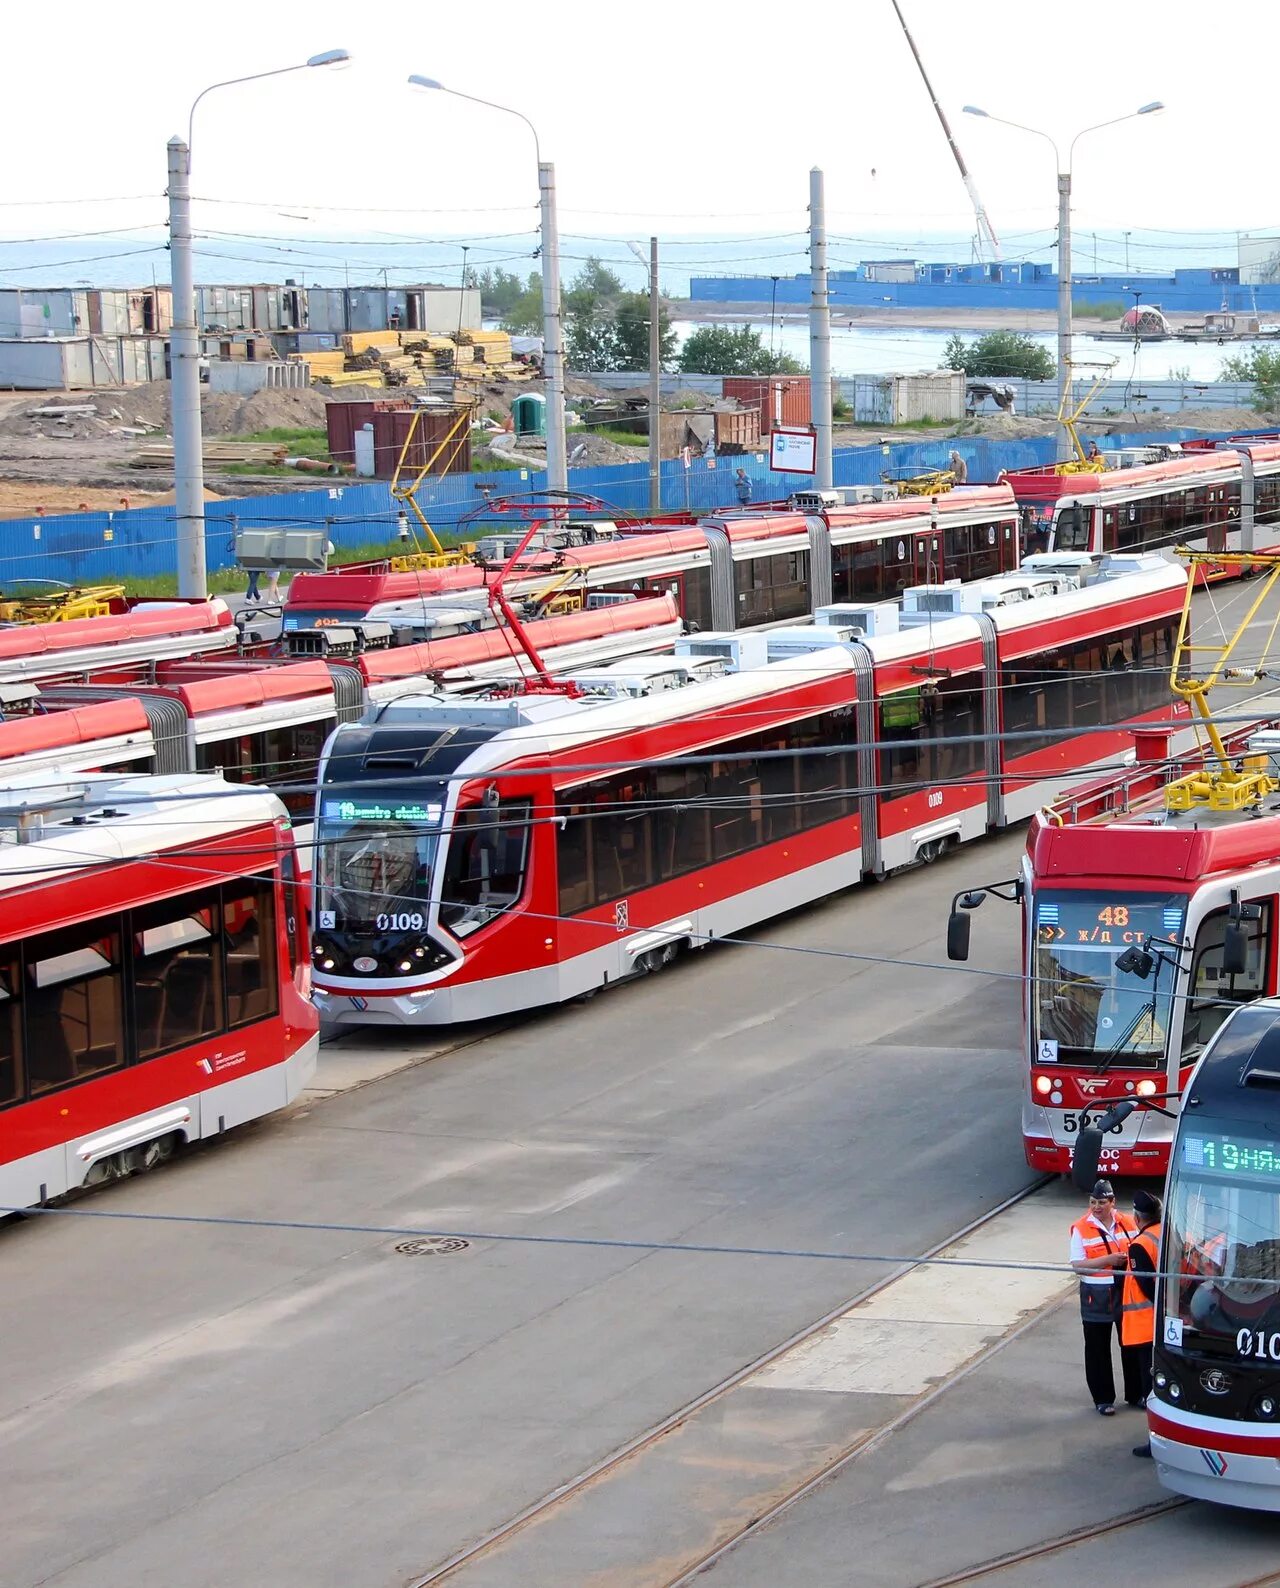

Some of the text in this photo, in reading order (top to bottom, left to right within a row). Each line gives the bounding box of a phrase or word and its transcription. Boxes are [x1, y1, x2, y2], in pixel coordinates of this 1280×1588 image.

[929, 791, 943, 808] 0109
[339, 802, 355, 820] 19
[376, 913, 423, 931] 0109
[1098, 906, 1129, 927] 48
[1203, 1141, 1239, 1170] 19
